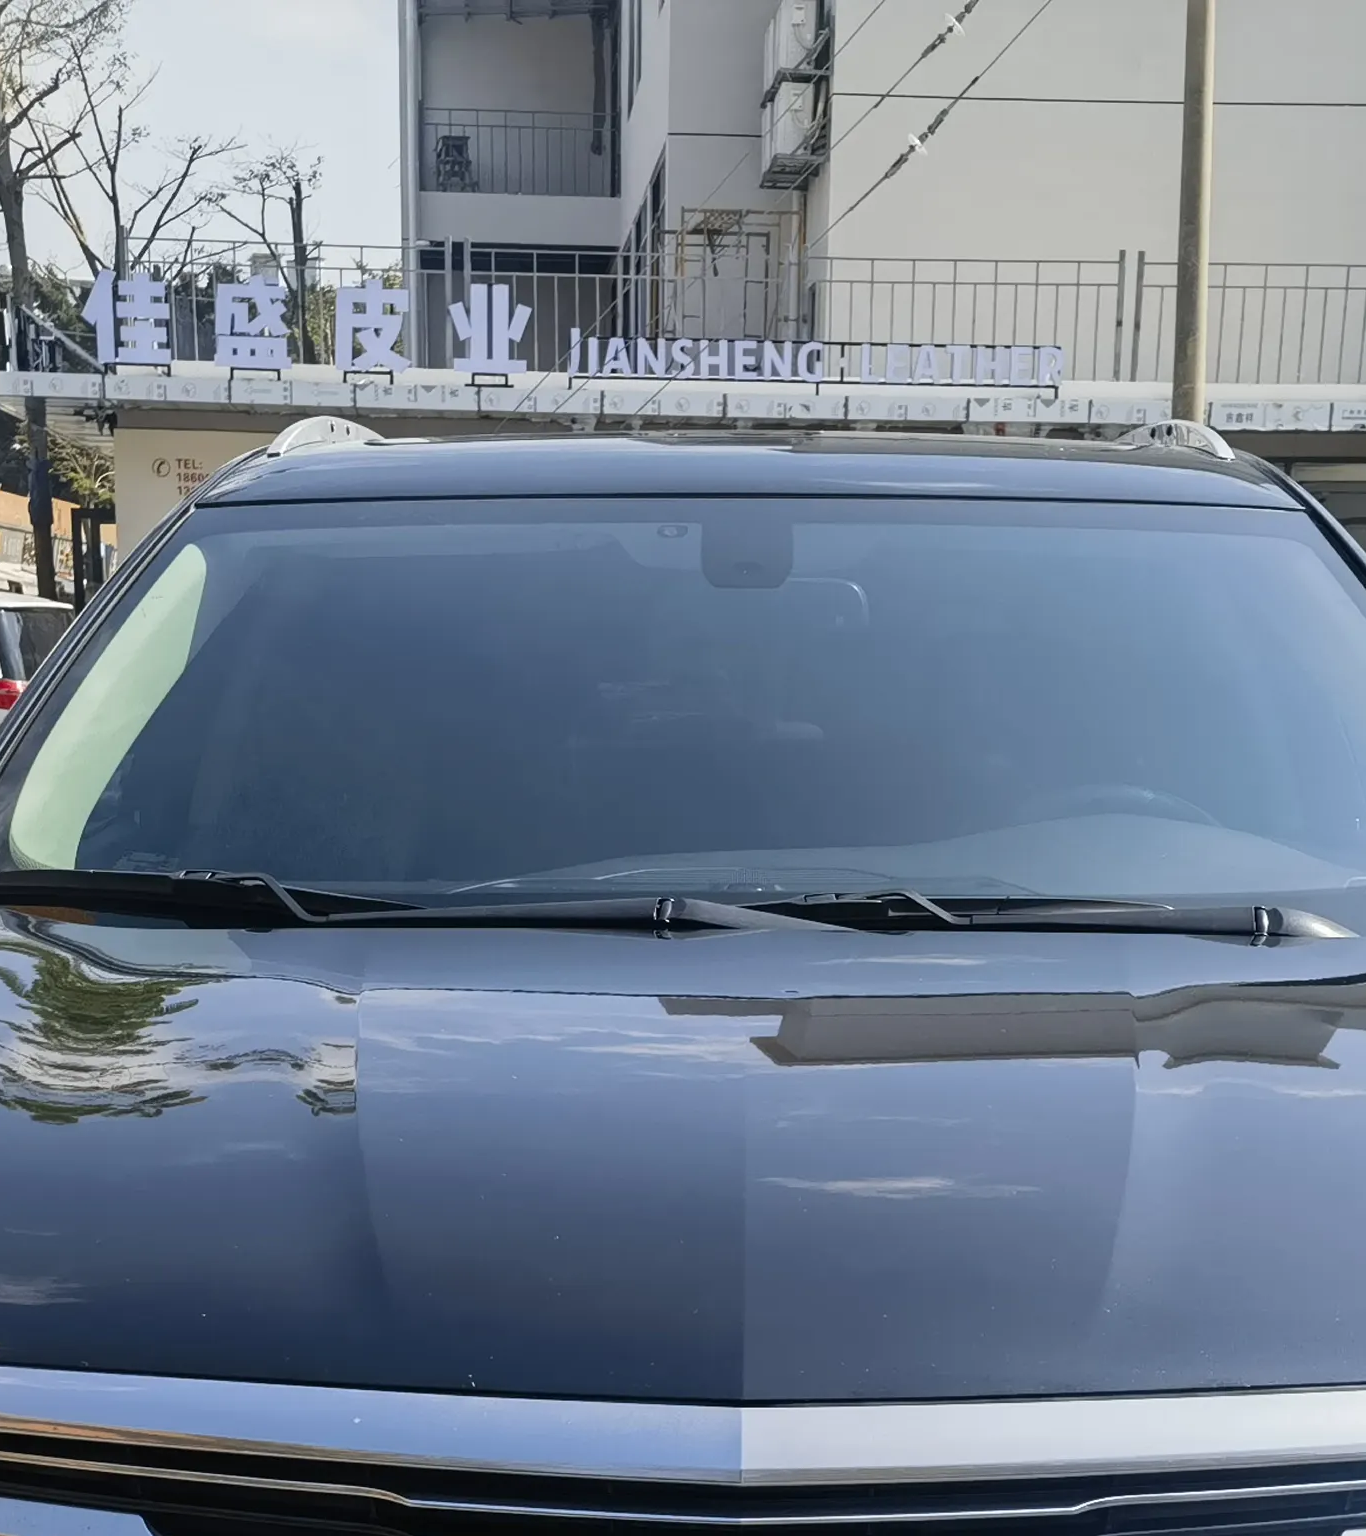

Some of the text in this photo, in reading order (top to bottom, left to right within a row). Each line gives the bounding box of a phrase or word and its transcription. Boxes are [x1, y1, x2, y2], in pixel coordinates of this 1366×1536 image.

[81, 267, 533, 374] 佳盛皮业
[567, 327, 1065, 387] JIANSHENG LEATHER
[176, 458, 204, 470] TEL:
